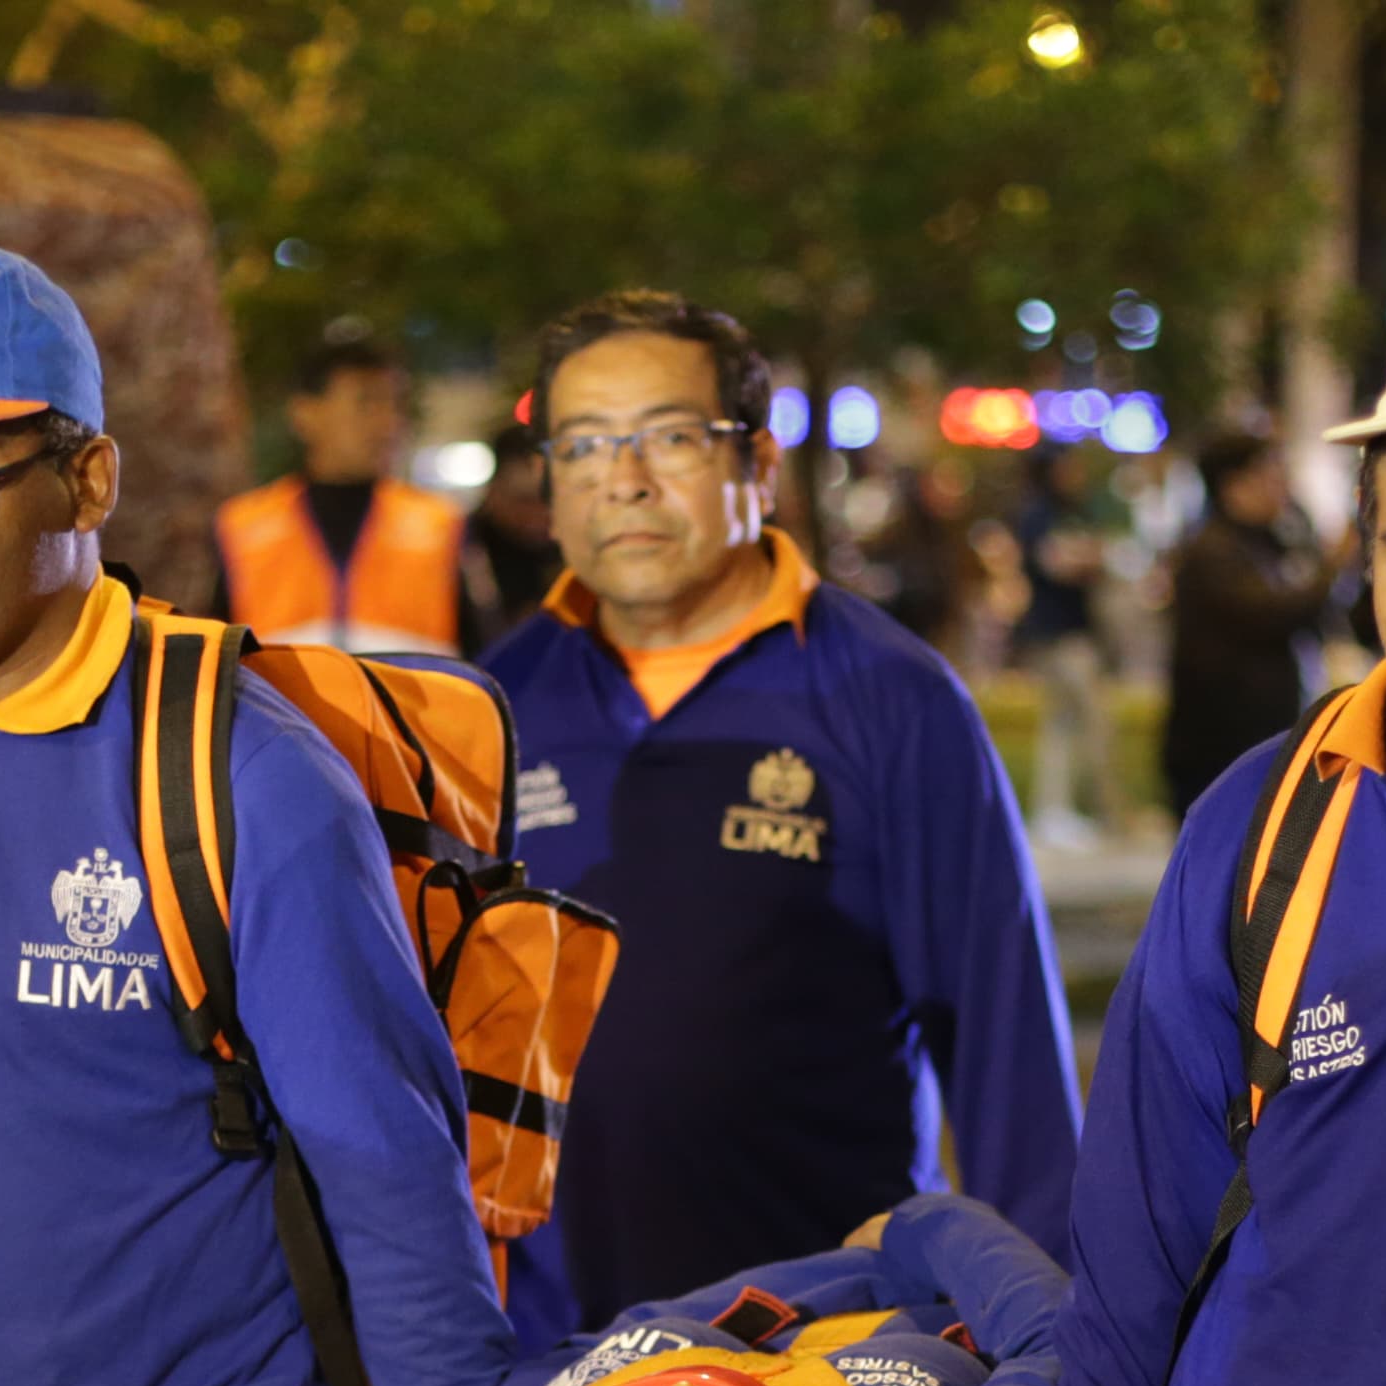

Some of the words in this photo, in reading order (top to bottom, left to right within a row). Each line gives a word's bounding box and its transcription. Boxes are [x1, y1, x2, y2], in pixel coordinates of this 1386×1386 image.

[20, 941, 138, 967] MUNICIPALIDAD
[138, 954, 160, 970] DE
[17, 960, 152, 1011] LIMA
[1292, 1026, 1360, 1063] RIESGO
